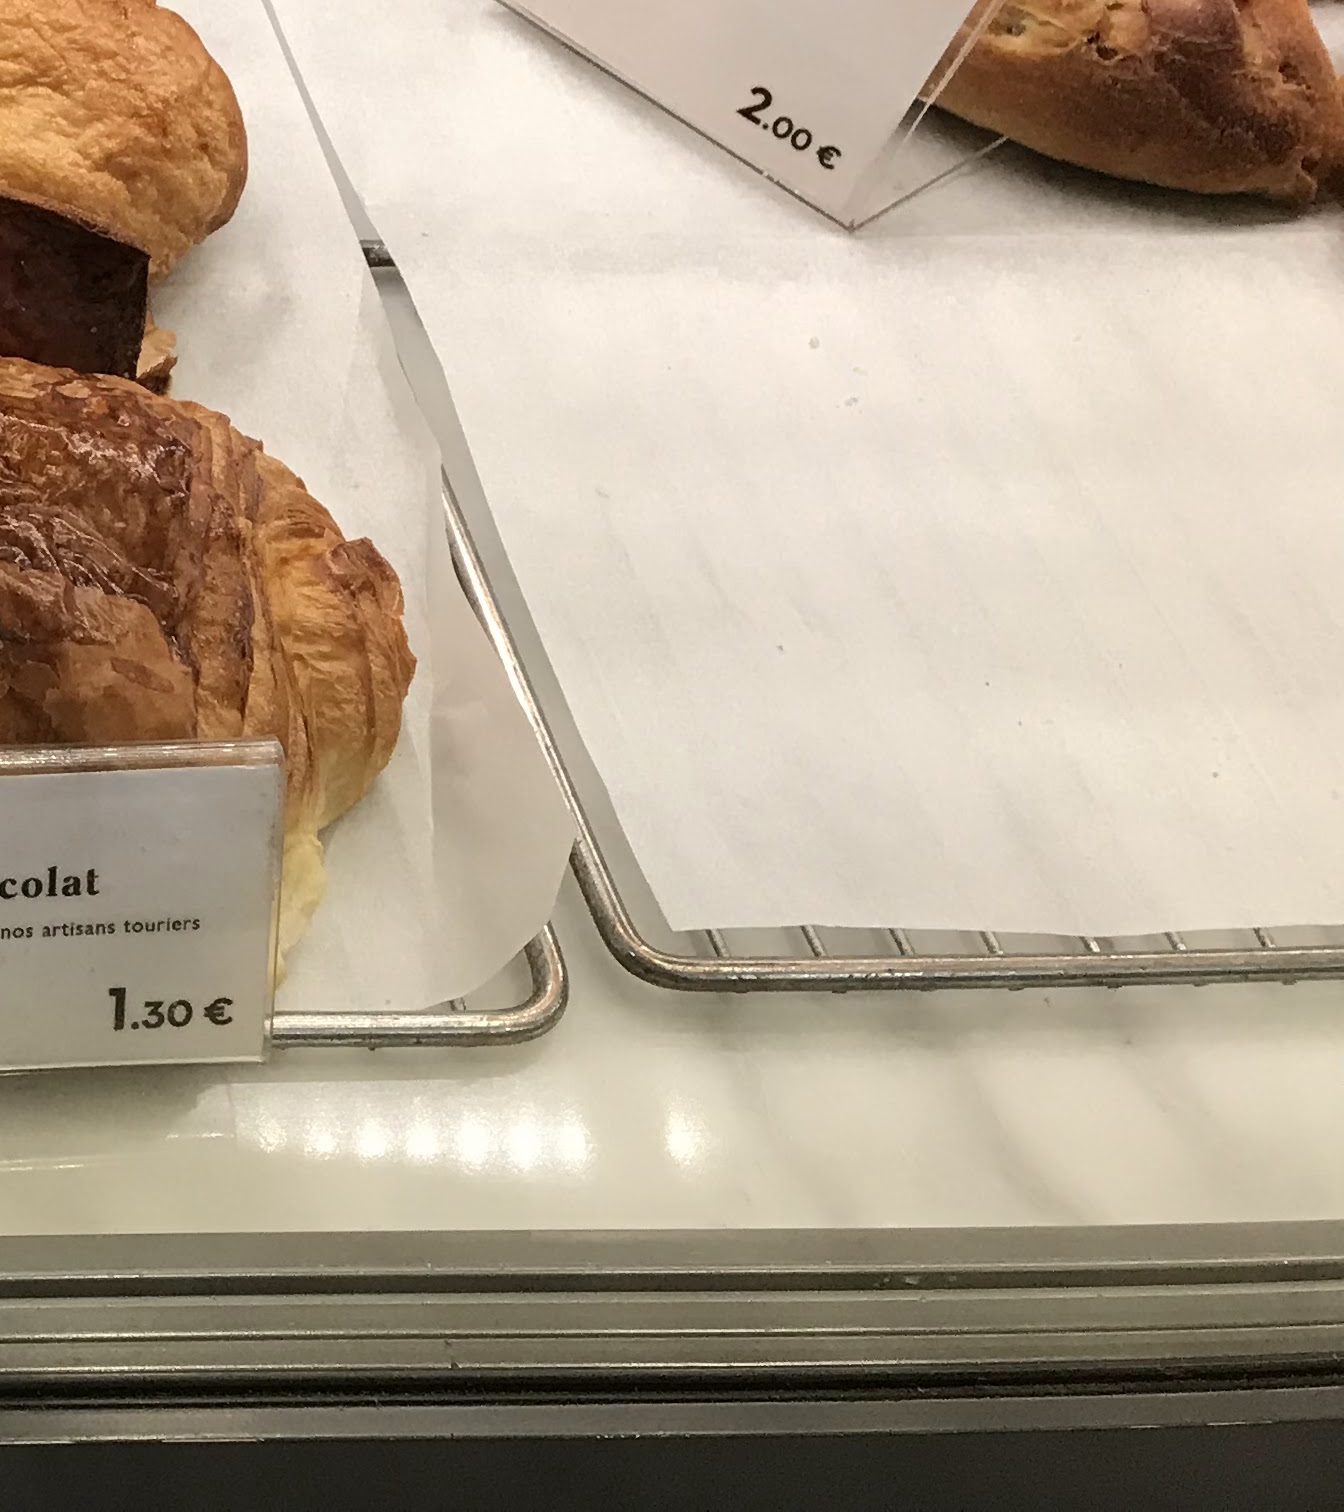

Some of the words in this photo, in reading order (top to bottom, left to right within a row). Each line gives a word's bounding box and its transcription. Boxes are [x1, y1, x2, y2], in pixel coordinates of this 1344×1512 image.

[0, 925, 34, 940] nos
[42, 920, 115, 938] artisans
[123, 916, 200, 935] touriers
